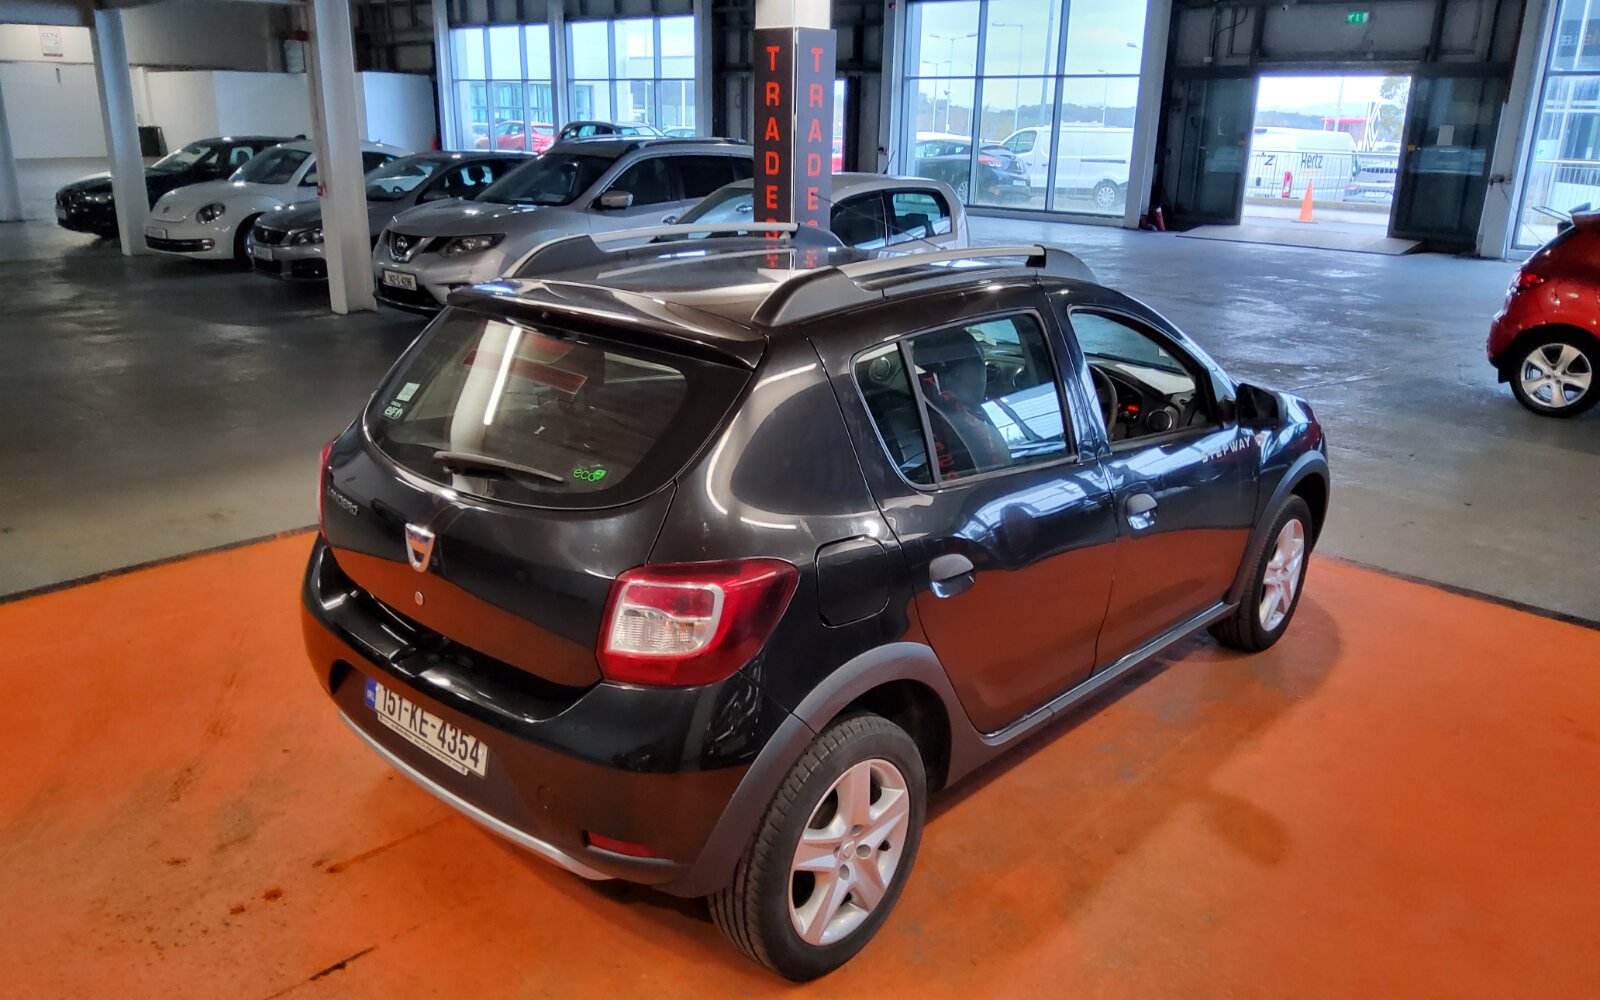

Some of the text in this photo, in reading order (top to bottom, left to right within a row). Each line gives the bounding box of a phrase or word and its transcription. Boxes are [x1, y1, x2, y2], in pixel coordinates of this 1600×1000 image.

[807, 48, 824, 226] TRADE
[1301, 153, 1324, 169] Hertz
[1202, 436, 1251, 464] STEPWAY
[382, 687, 481, 768] 151-KE-4354
